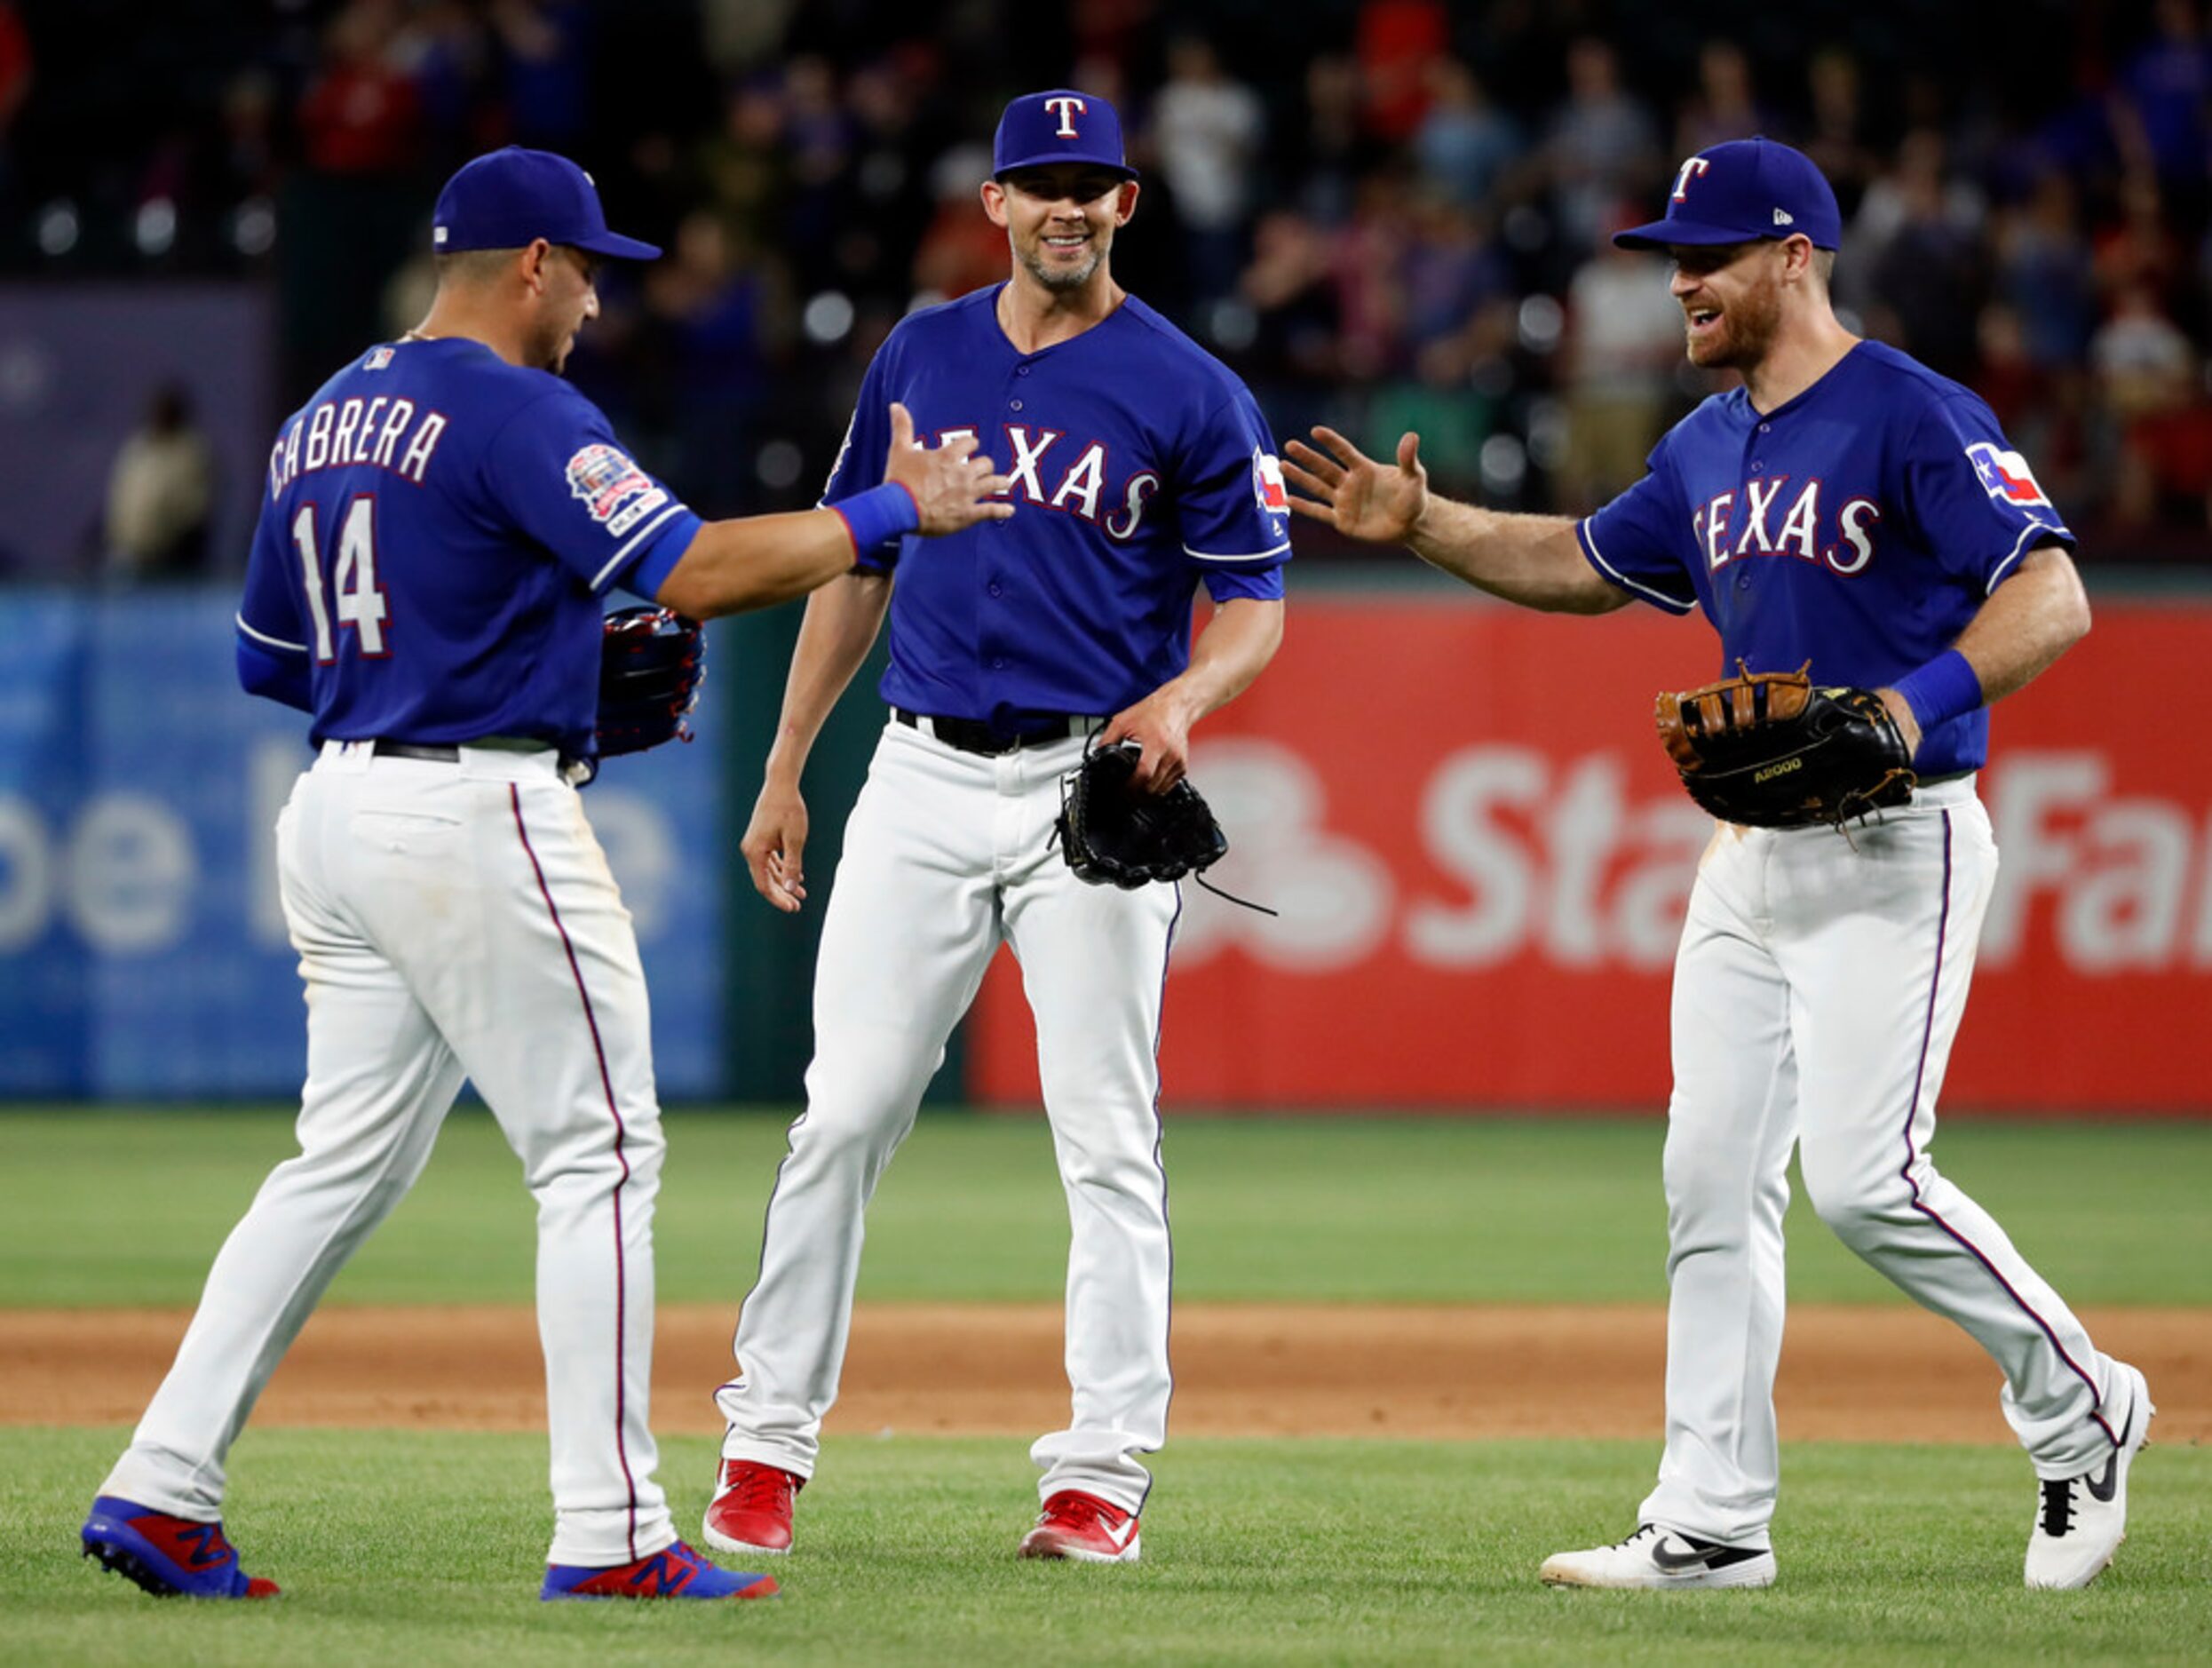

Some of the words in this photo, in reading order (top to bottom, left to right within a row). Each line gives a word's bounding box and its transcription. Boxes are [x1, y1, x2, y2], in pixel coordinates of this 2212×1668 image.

[1044, 97, 1087, 139] T
[1672, 157, 1709, 203] T
[269, 395, 448, 504] CABRERA
[912, 424, 1161, 542] XAS
[292, 495, 392, 663] 14
[1410, 743, 1716, 968] Sta
[1984, 751, 2212, 972] Fa
